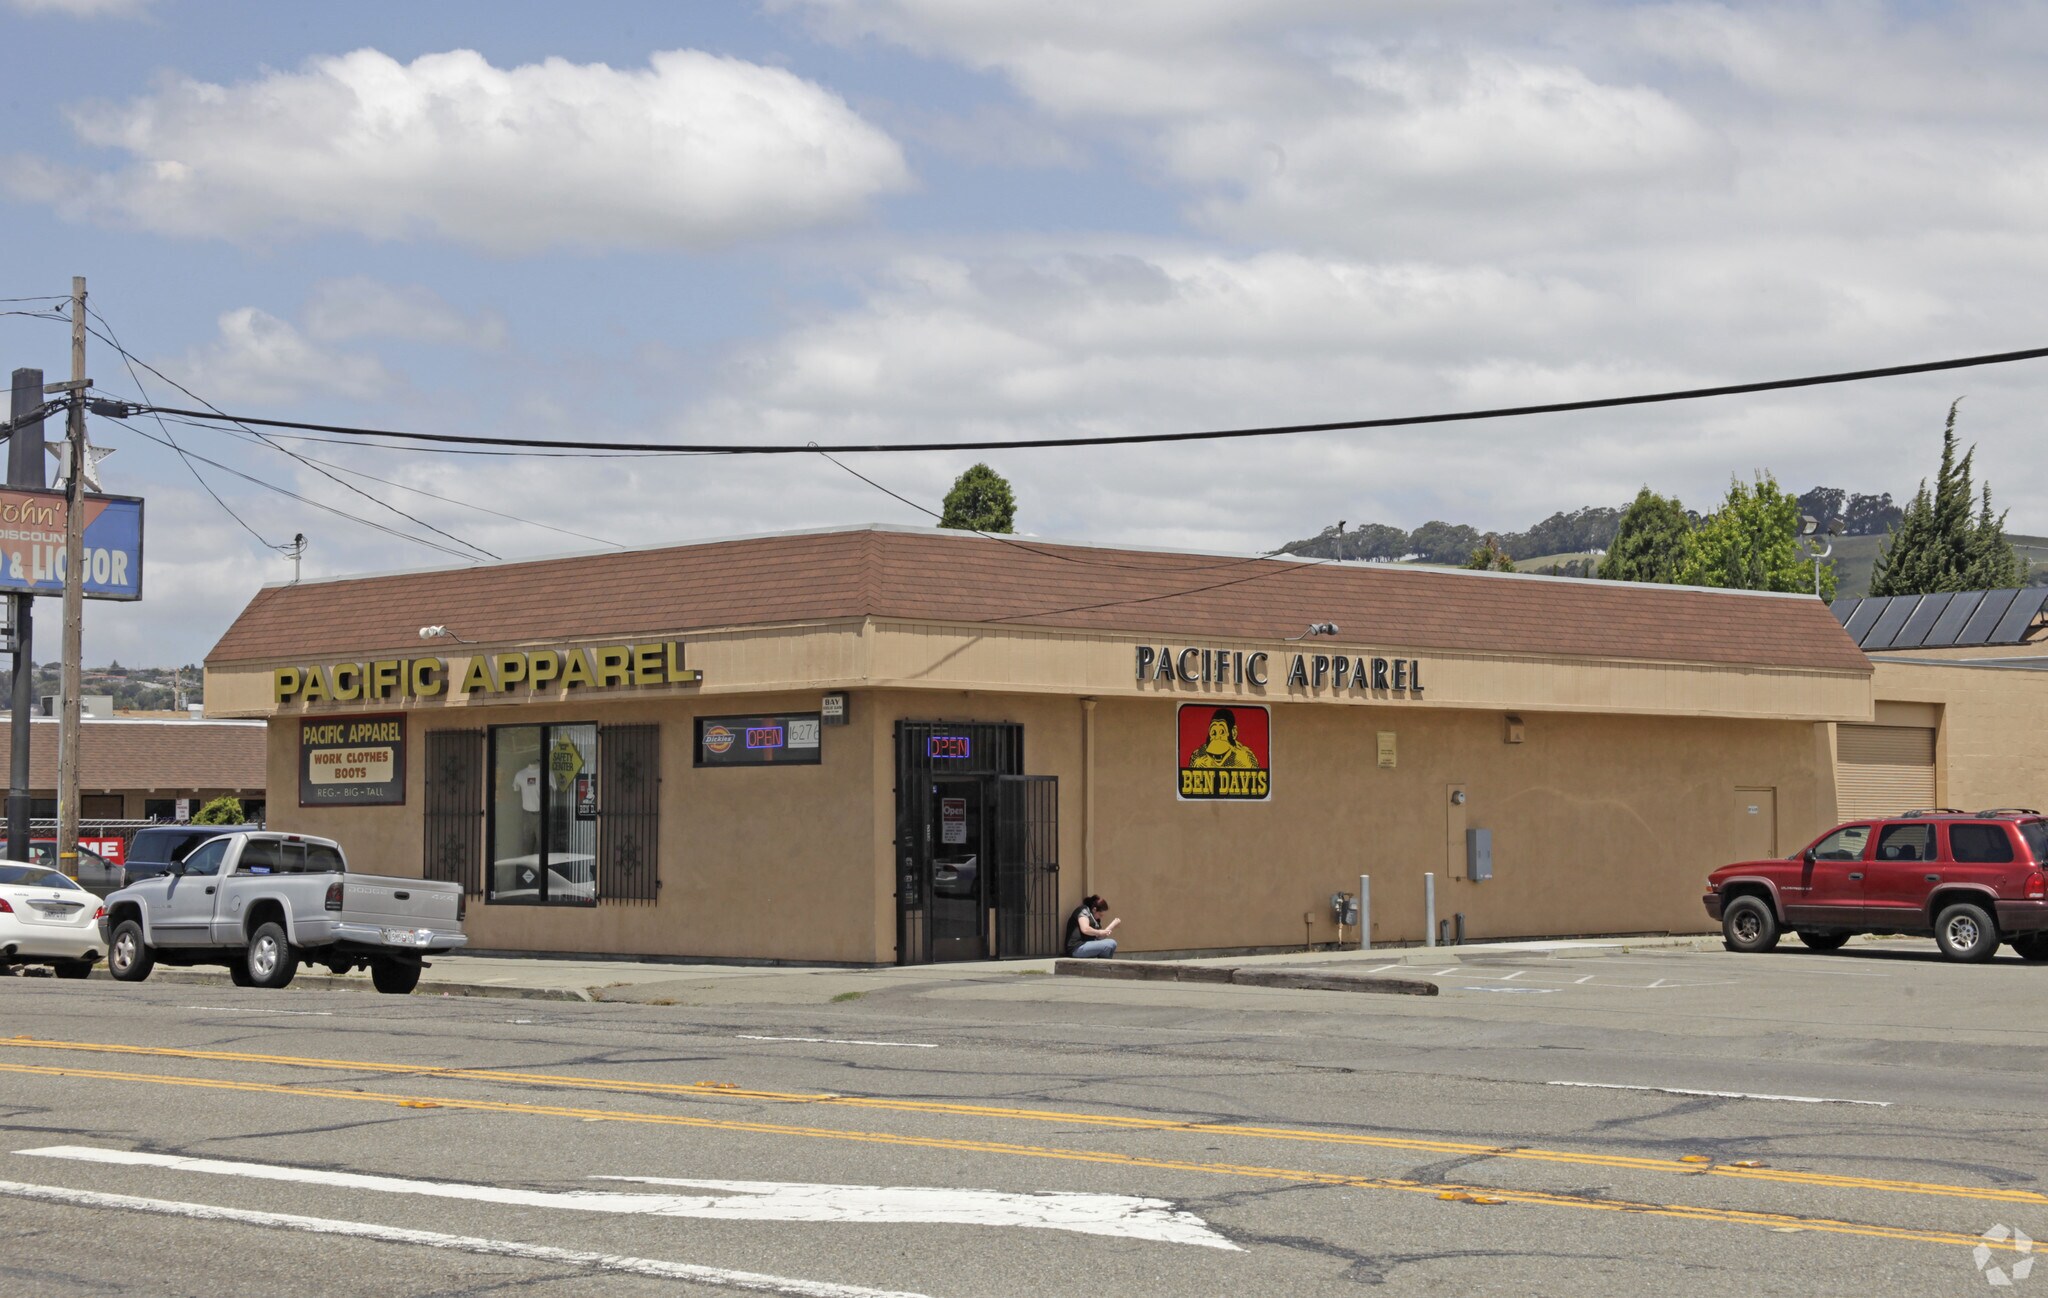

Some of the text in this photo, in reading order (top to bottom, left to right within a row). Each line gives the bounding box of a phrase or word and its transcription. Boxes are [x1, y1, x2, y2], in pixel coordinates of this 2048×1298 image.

[0, 498, 67, 529] ohn'
[9, 551, 24, 579] &
[274, 641, 697, 703] PACIFIC APPAREL
[1135, 645, 1425, 692] PACIFIC APPAREL
[824, 698, 840, 706] BAY
[303, 722, 400, 745] PACIFIC APPAREL
[748, 729, 781, 746] OPEN
[931, 739, 967, 756] OPEN
[314, 751, 389, 764] WORK CLOTHES
[553, 752, 573, 761] SAFETY
[335, 767, 367, 778] BOOTS
[552, 762, 574, 771] CENTER
[1181, 770, 1267, 796] BEN DAVIS
[943, 806, 963, 815] Open
